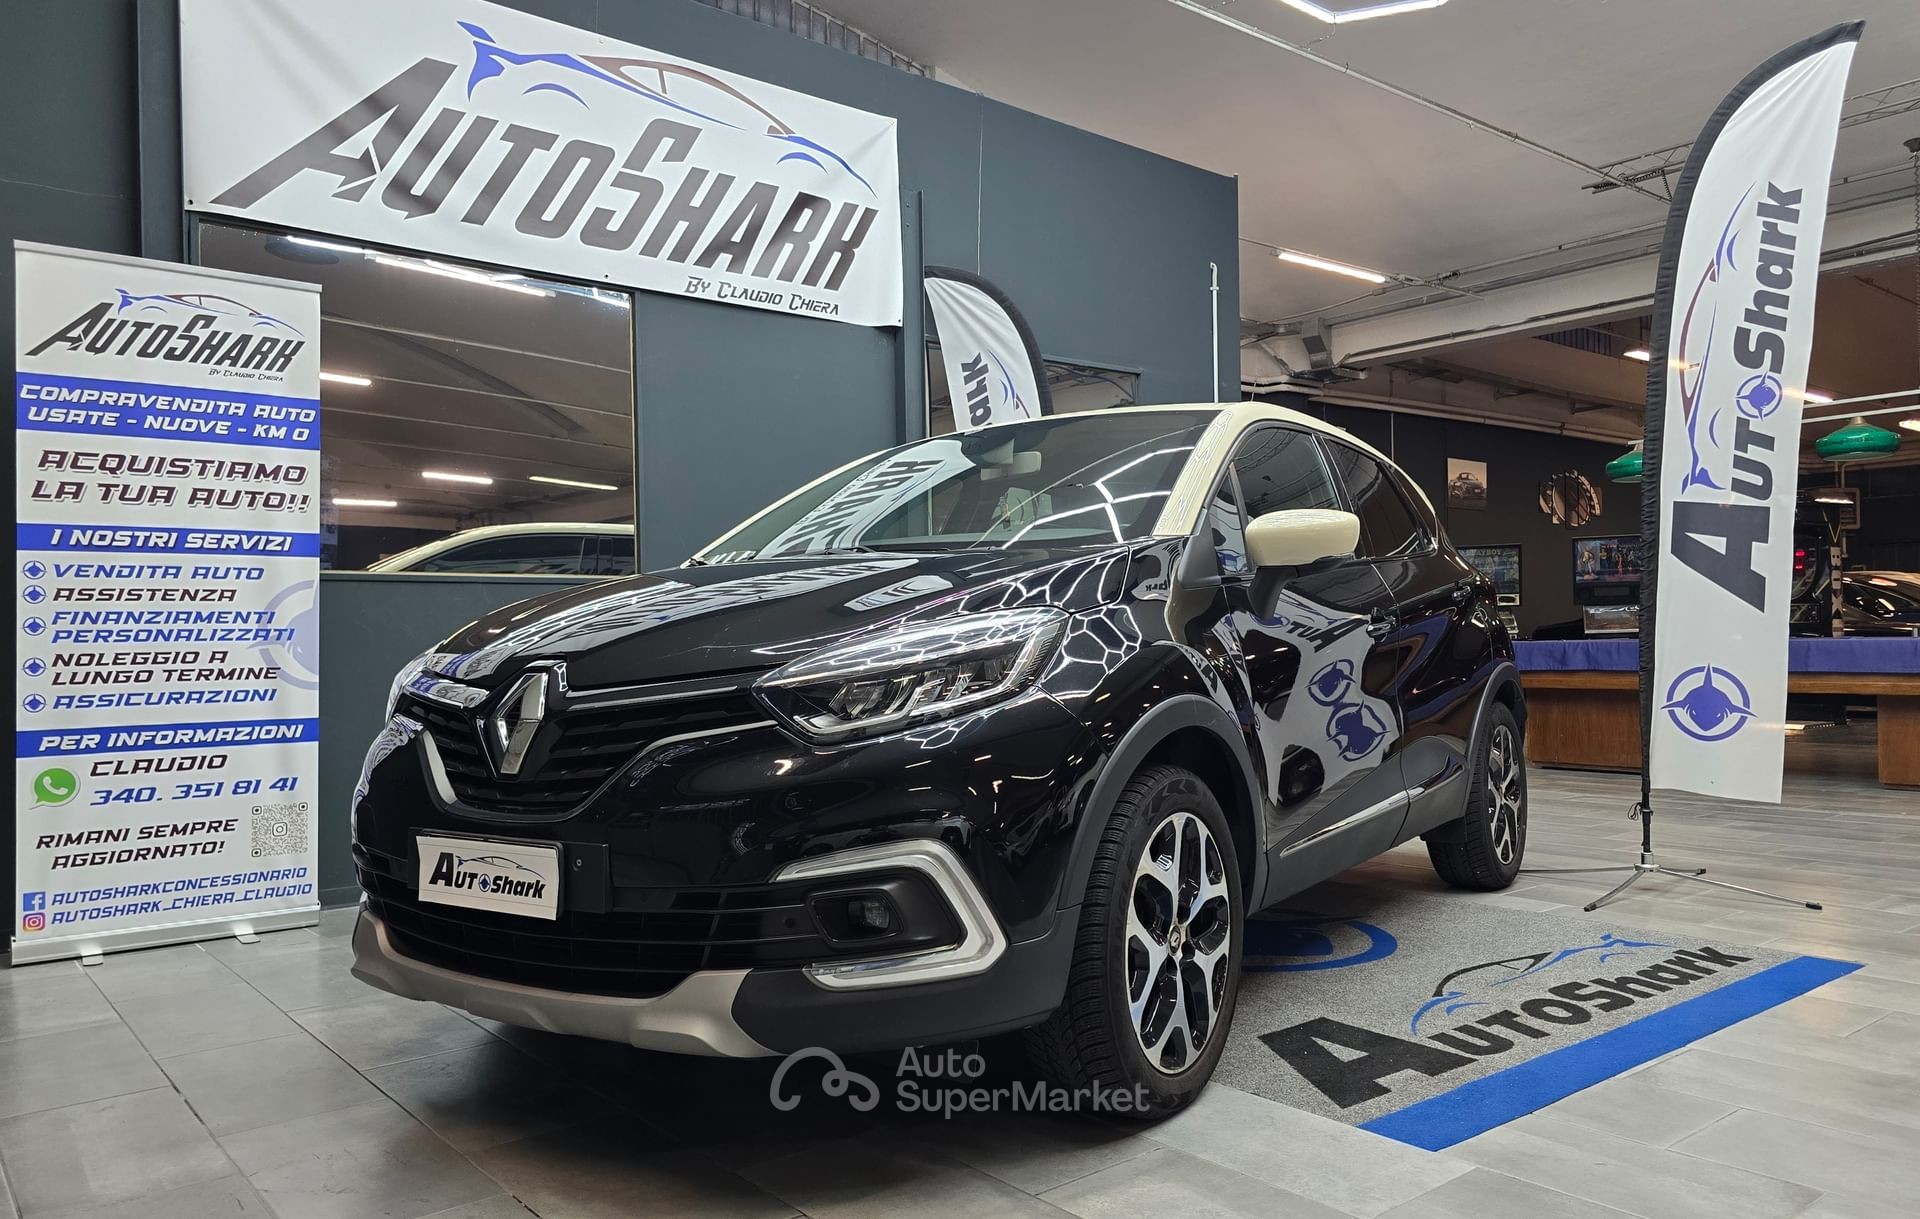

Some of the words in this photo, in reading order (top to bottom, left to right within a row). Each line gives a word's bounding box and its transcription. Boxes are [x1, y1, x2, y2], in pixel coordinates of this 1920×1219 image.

[208, 57, 878, 292] AUTOSHARK
[685, 276, 711, 294] BY
[717, 281, 783, 305] CLAUDIO
[788, 293, 839, 316] CHIERA
[24, 302, 305, 374] AUTOSHARK
[208, 368, 221, 376] BY
[222, 370, 256, 379] CLAUDIO
[258, 373, 284, 383] CHIERA
[20, 384, 246, 417] COMPRAVENDITA
[252, 404, 317, 423] AUTO
[27, 406, 119, 427] USATE
[143, 415, 232, 435] NUOVE
[252, 424, 285, 441] KM
[38, 449, 308, 485] ACQUISTIAMO
[31, 479, 87, 503] LA
[96, 482, 178, 507] TUA
[187, 487, 312, 513] AUTO!!
[50, 529, 63, 546] I
[69, 529, 178, 549] NOSTRI
[184, 534, 293, 551] SERVIZI
[53, 563, 183, 580] VENDITA
[190, 565, 265, 581] AUTO
[52, 587, 237, 602] ASSISTENZA
[51, 611, 276, 626] FINANZIAMENTI
[50, 628, 296, 644] PERSONALIZZATI
[51, 651, 201, 668] NOLEGGIO
[208, 650, 229, 664] A
[51, 669, 155, 686] LUNGO
[163, 667, 280, 683] TERMINE
[52, 688, 278, 710] ASSICURAZIONI
[39, 734, 101, 752] PER
[107, 724, 304, 748] INFORMAZIONI
[90, 754, 228, 778] CLAUDIO
[90, 786, 163, 806] 340.
[172, 781, 224, 800] 351
[231, 779, 262, 796] 81
[268, 776, 299, 793] 41
[36, 828, 130, 849] RIMANI
[136, 818, 239, 840] SEMPRE
[51, 840, 225, 870] AGGIORNATO!
[51, 867, 308, 906] AUTOSHARKCONCESSIONARIO
[51, 884, 312, 925] AUTOSHARK_CHIERA_CLAUDIO
